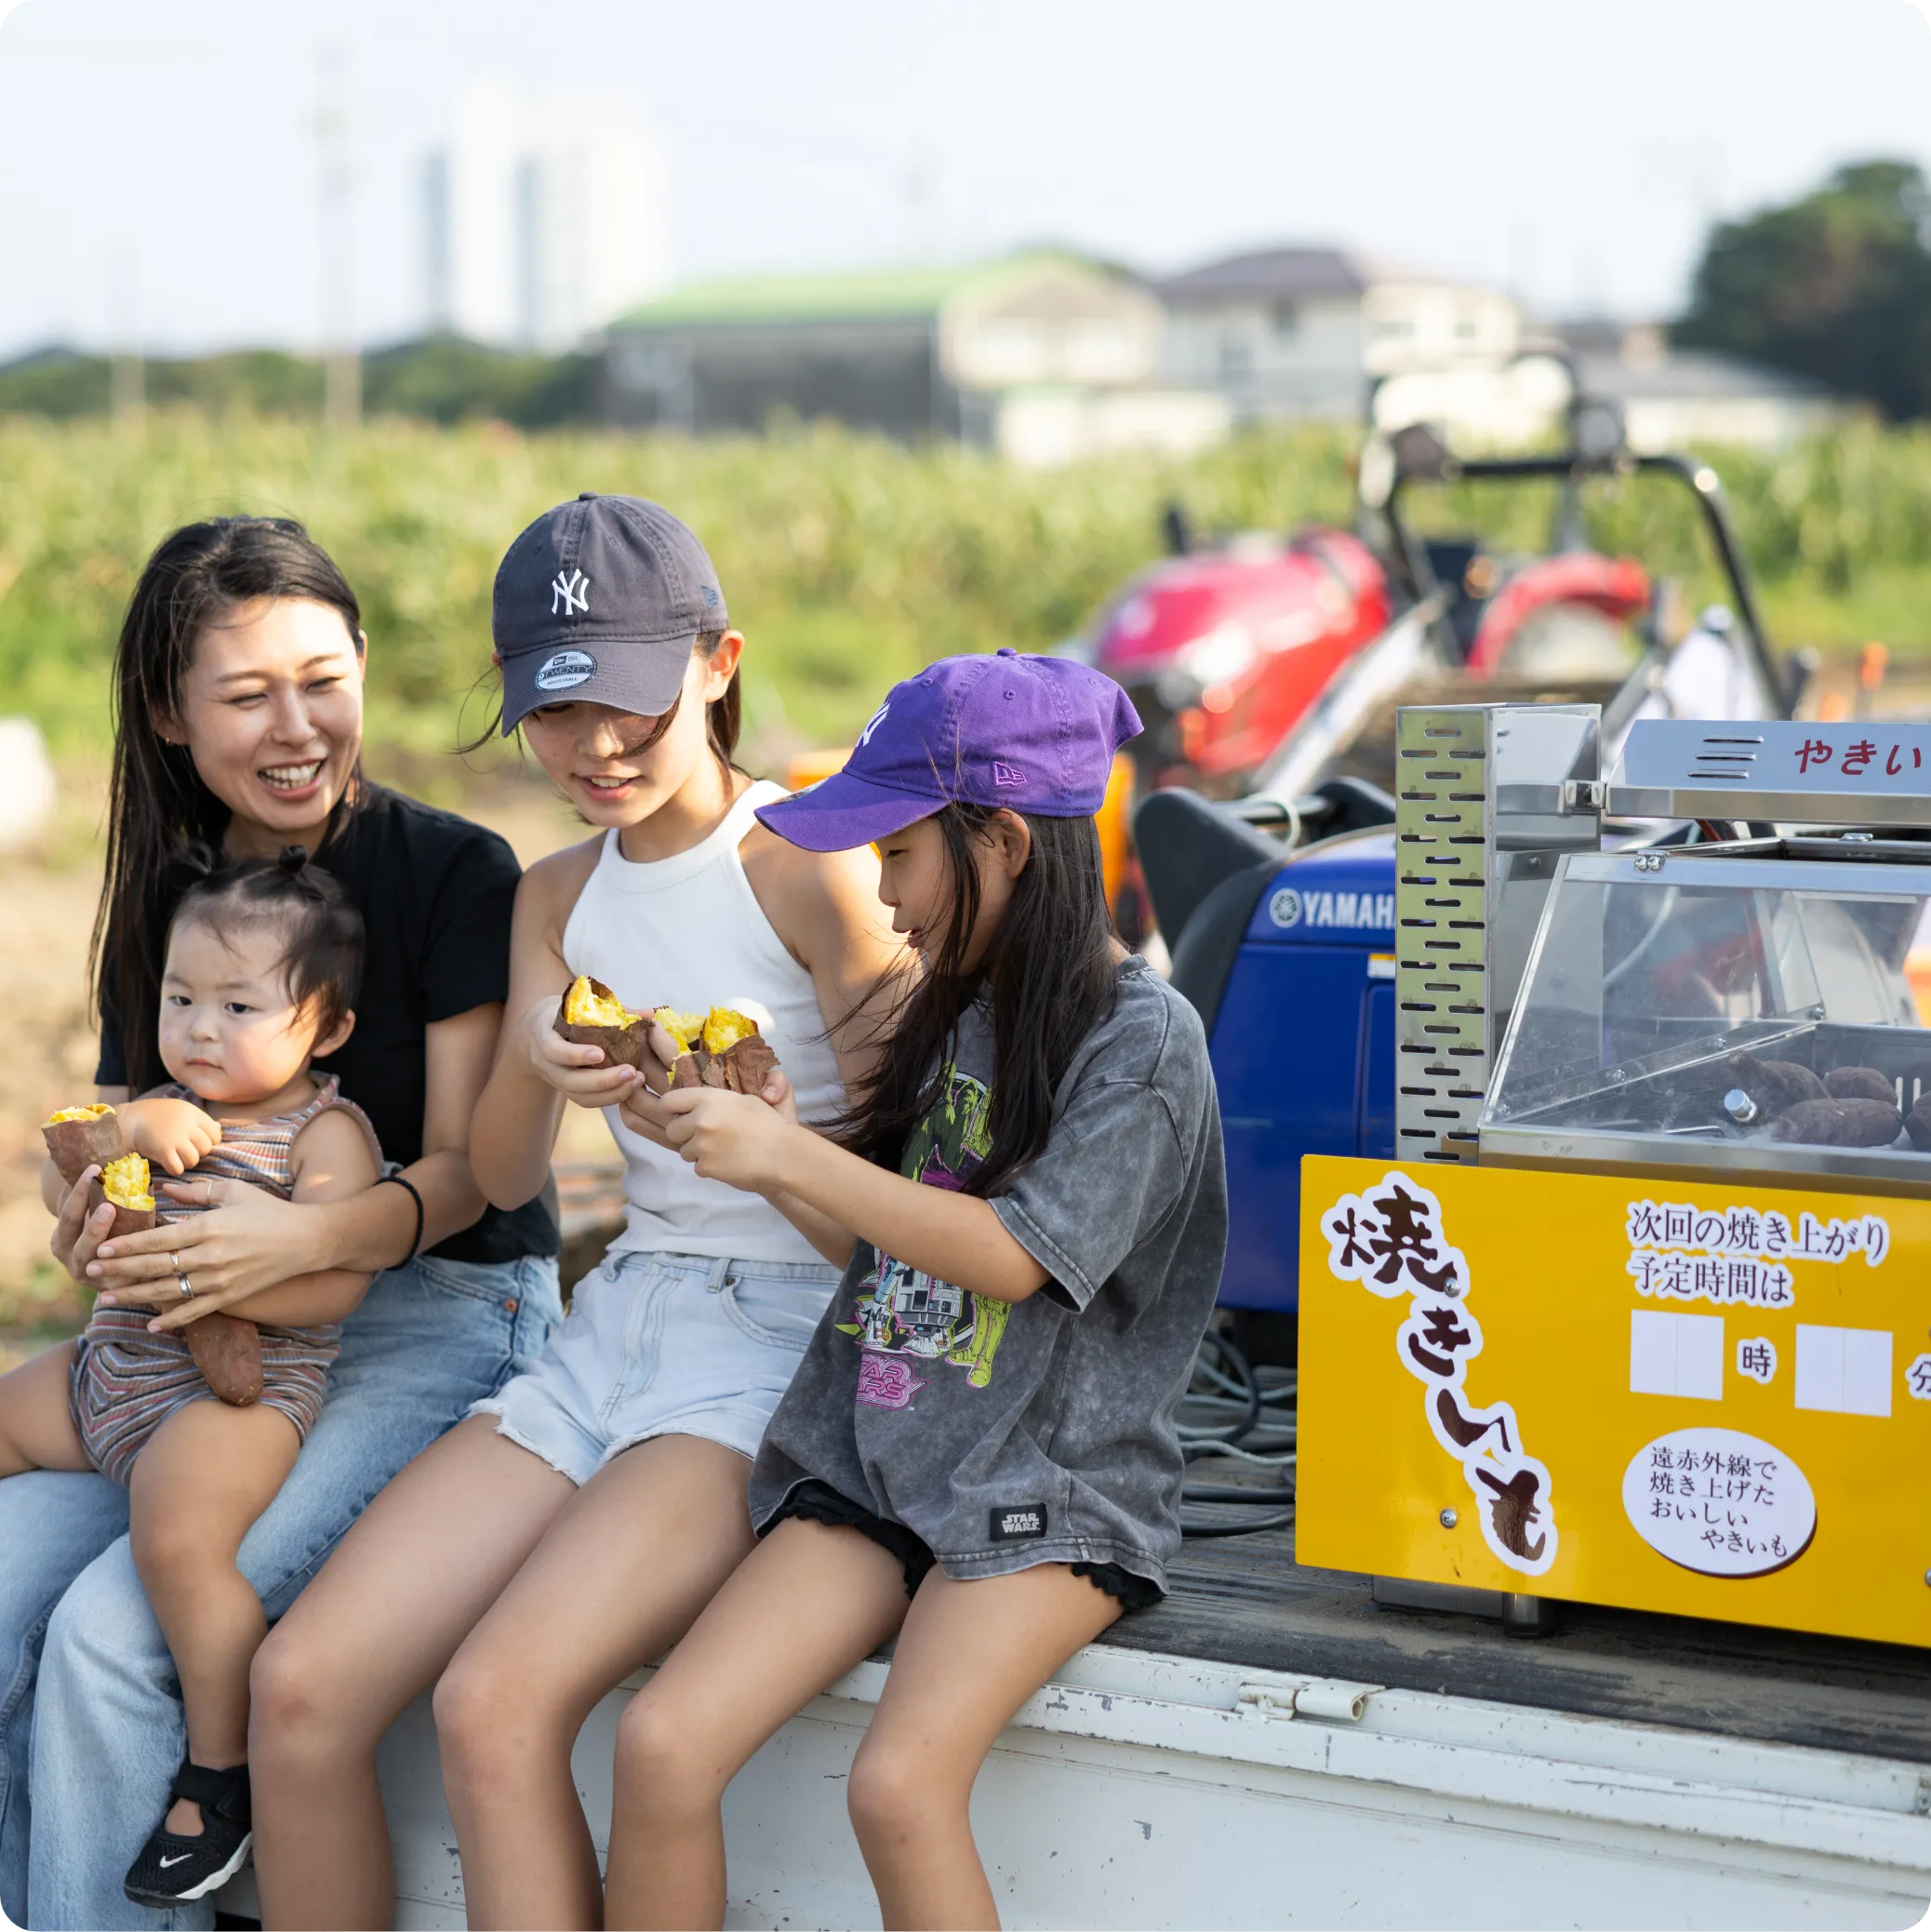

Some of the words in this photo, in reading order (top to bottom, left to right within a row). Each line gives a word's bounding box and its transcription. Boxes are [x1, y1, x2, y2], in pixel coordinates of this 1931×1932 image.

[552, 568, 589, 615] NY
[538, 665, 593, 681] 9TWENTY
[1303, 891, 1395, 929] YAMAH
[1631, 1206, 1884, 1259] 次回の焼き上がり
[1631, 1256, 1789, 1302] 予定時間は
[1332, 1184, 1546, 1562] 焼きいも
[1742, 1344, 1771, 1377] 時
[1650, 1446, 1778, 1480] 遠赤外線で
[1649, 1471, 1776, 1506] 焼き上げた
[1002, 1512, 1039, 1523] STAR
[1002, 1521, 1040, 1533] WARS
[1650, 1498, 1749, 1526] おいしい
[1700, 1529, 1787, 1557] やきいも
